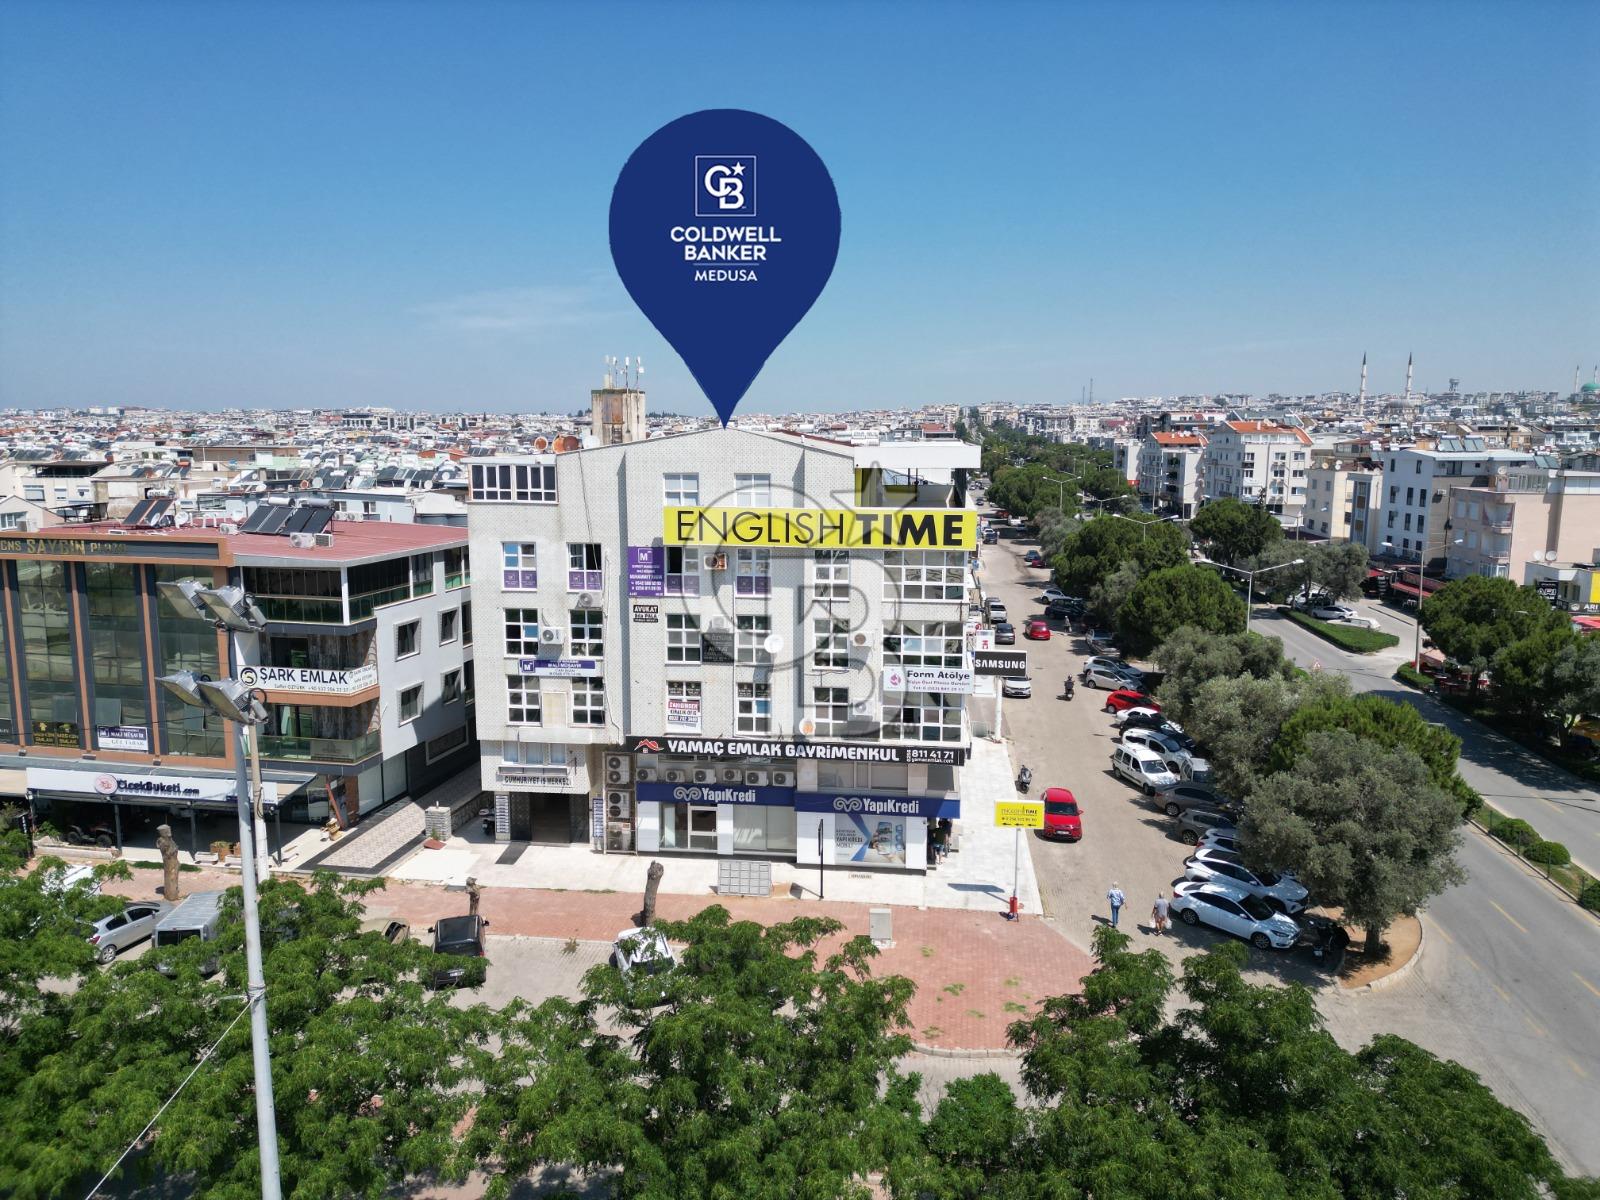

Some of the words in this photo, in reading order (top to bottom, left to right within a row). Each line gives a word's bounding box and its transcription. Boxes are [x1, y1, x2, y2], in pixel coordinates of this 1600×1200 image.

[677, 510, 844, 545] ENGLISH
[855, 513, 964, 546] TIME
[975, 659, 1026, 669] SAMSUNG
[260, 667, 296, 684] ŞARK
[300, 670, 348, 684] EMLAK
[938, 671, 970, 681] Atölye
[667, 740, 724, 756] YAMAÇ
[728, 744, 782, 757] EMLAK
[785, 744, 900, 762] GAYRİMENKUL
[912, 750, 928, 758] 811
[930, 750, 942, 759] 41
[943, 751, 954, 760] 71
[702, 788, 756, 803] YapıKredi
[862, 798, 919, 814] YapıKredi
